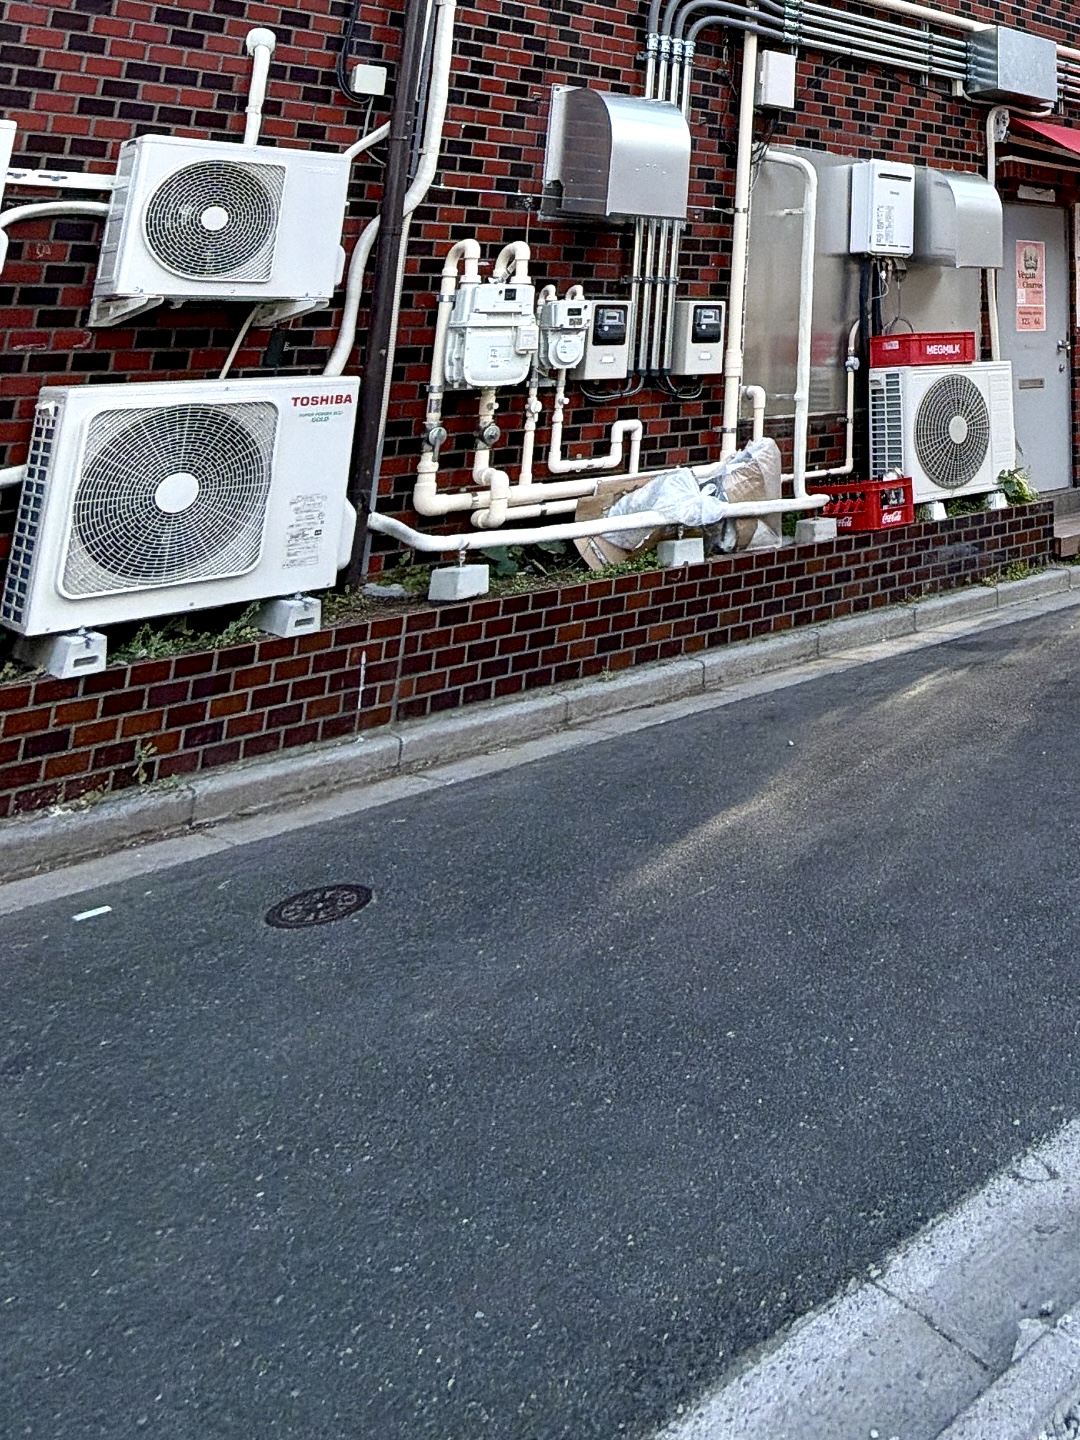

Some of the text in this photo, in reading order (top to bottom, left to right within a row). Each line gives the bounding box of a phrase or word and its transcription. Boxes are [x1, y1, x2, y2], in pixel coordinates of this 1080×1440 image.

[926, 344, 960, 355] MEGMILK
[291, 394, 352, 407] TOSHIBA
[882, 510, 902, 524] Coca-Cola
